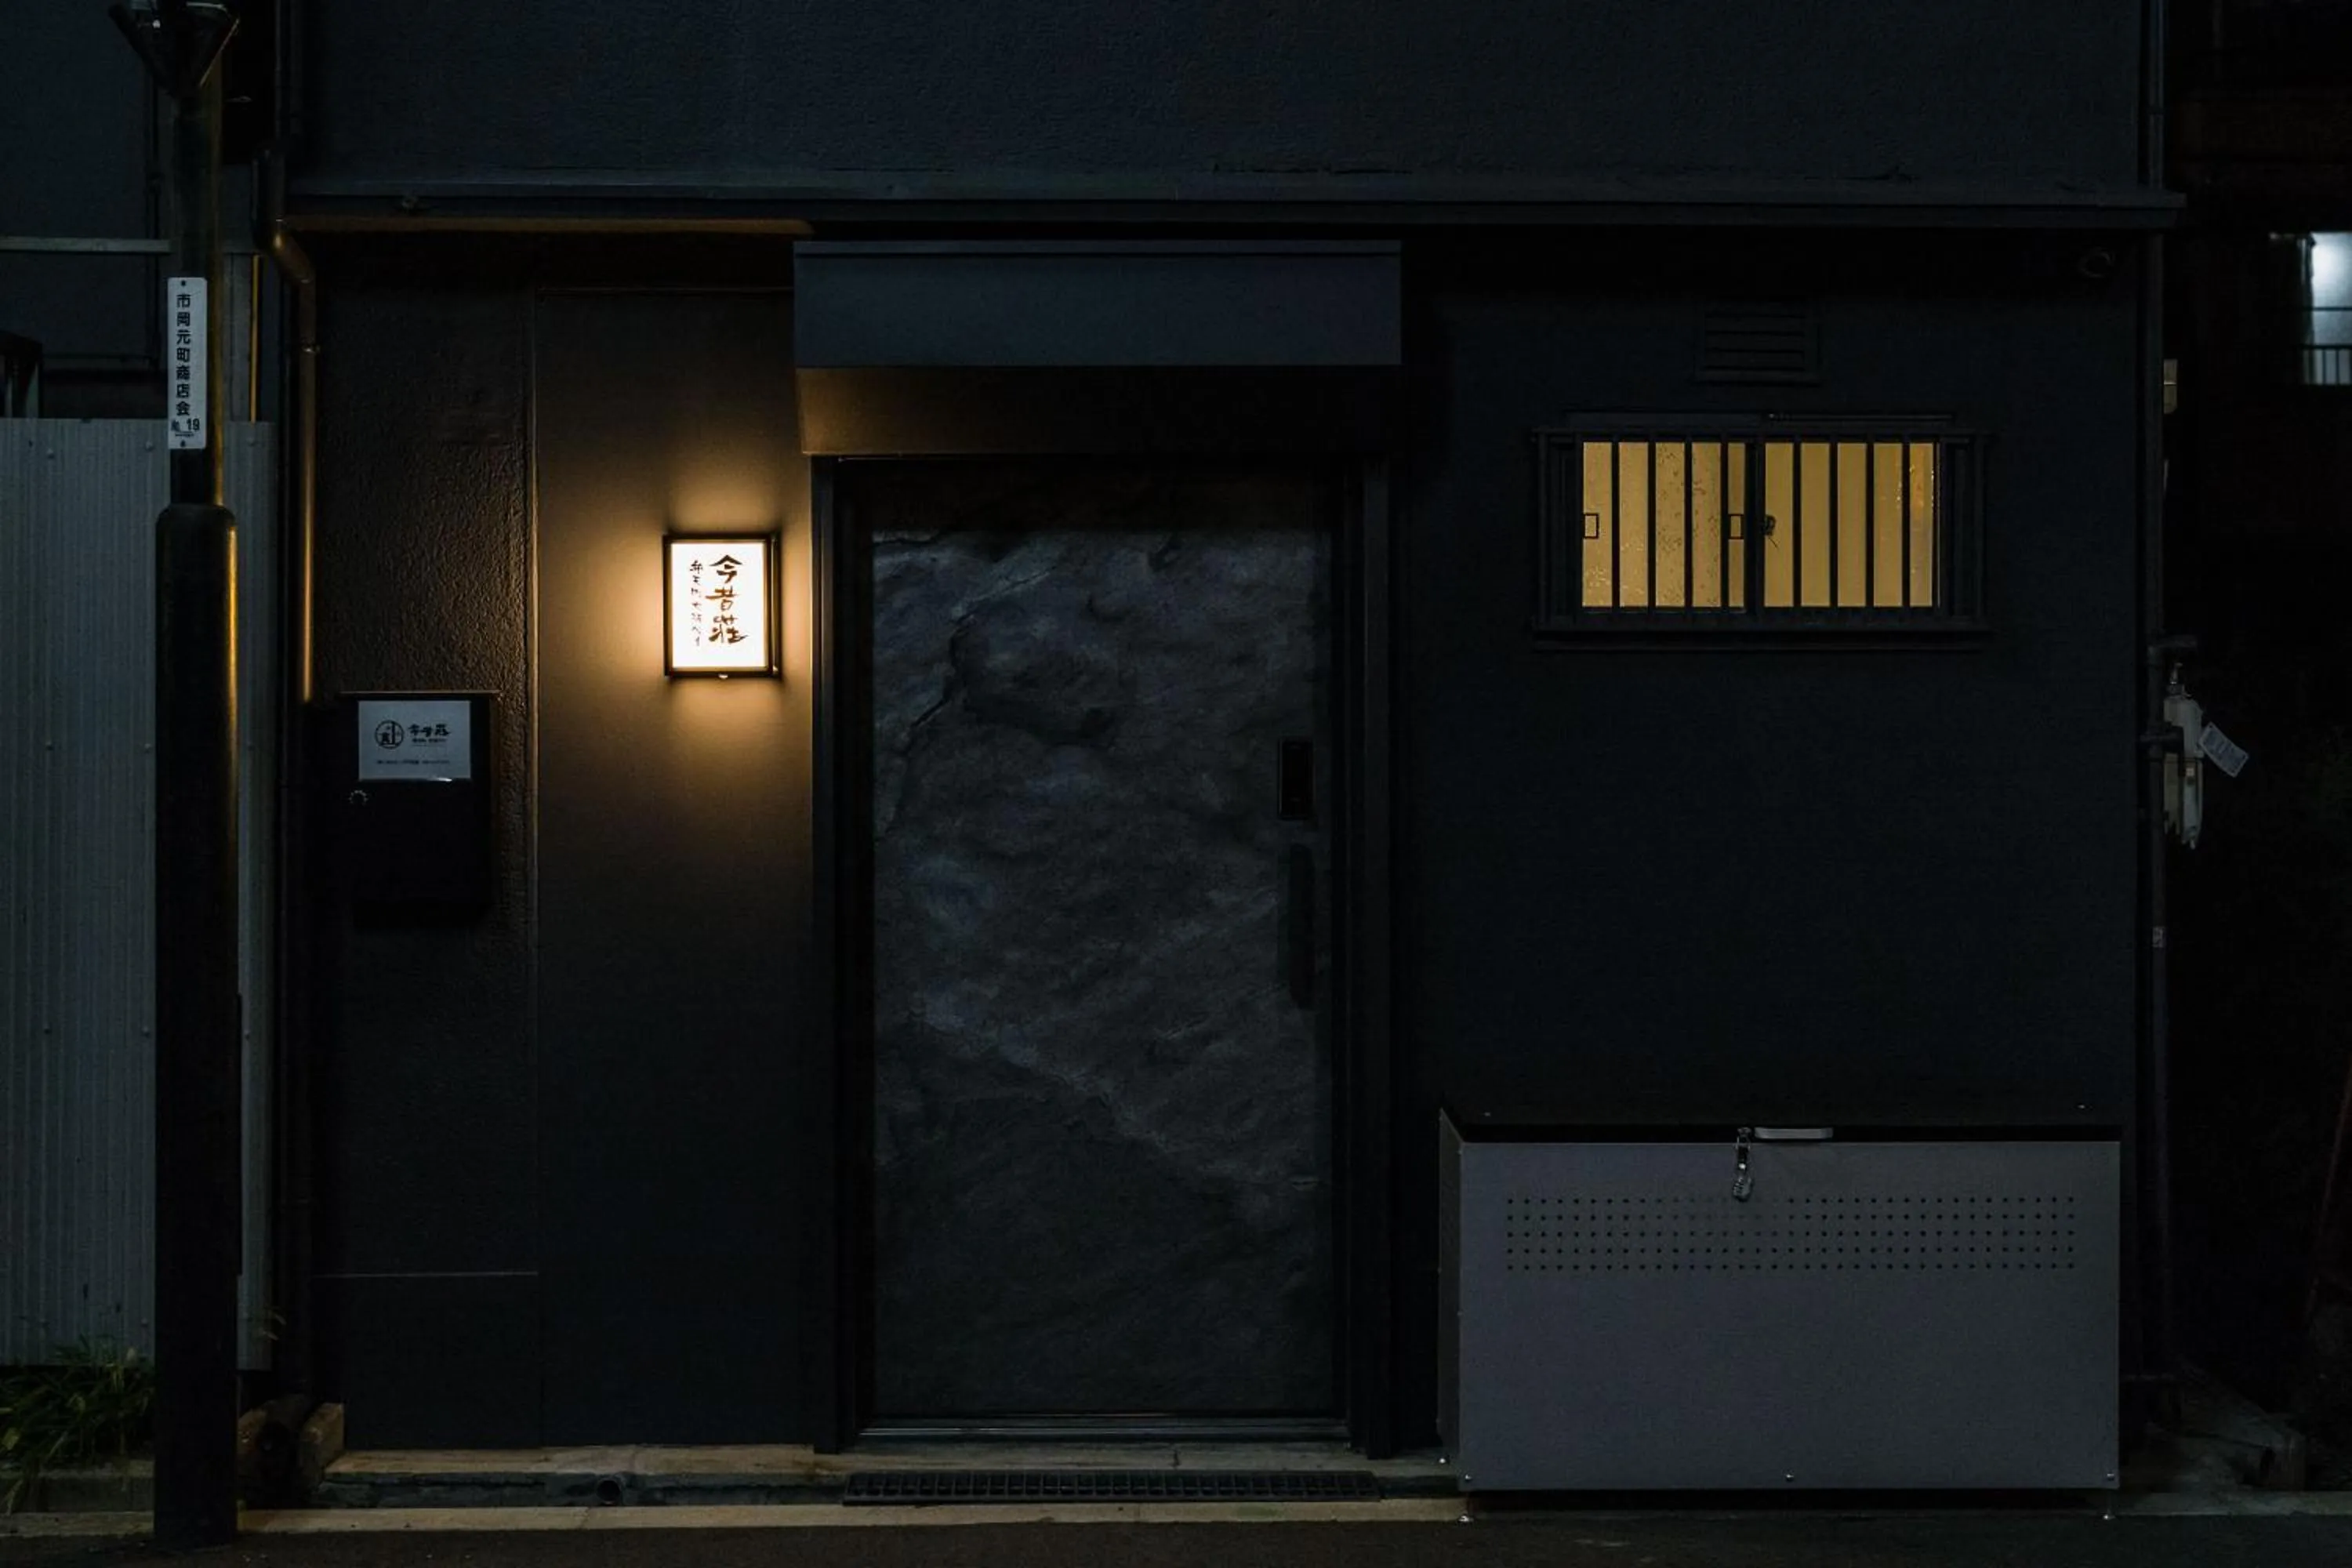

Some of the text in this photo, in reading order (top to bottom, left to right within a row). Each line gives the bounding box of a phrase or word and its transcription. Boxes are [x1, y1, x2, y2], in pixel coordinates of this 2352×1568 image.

[176, 293, 191, 416] 市岡元町商店会
